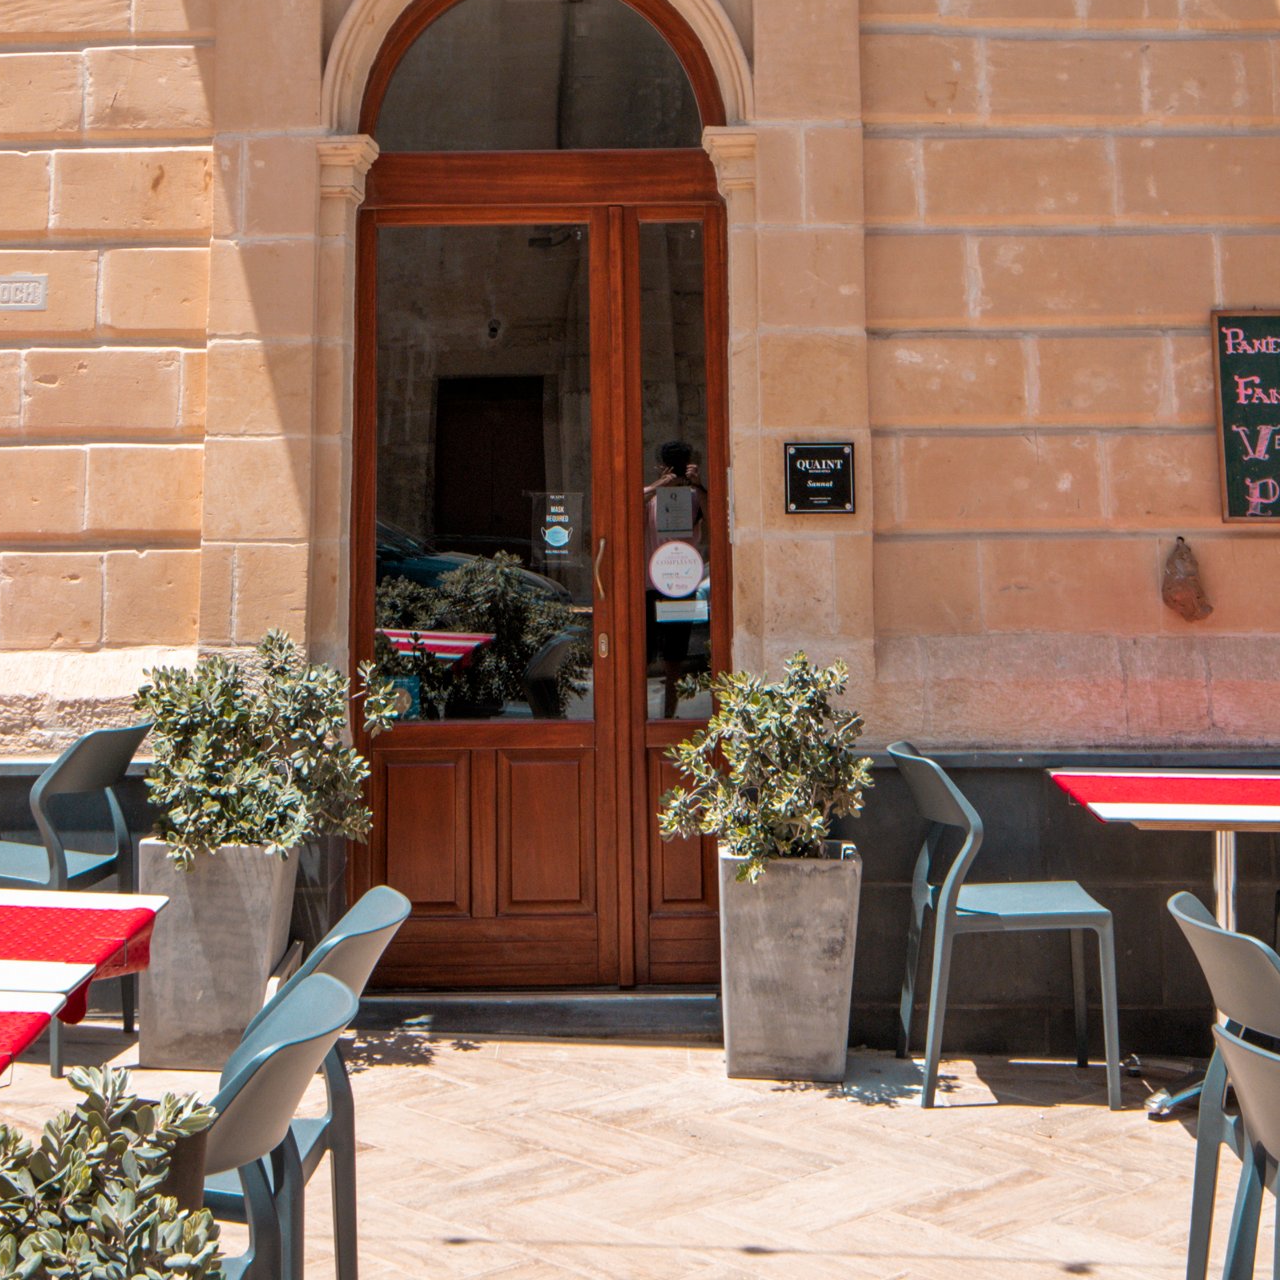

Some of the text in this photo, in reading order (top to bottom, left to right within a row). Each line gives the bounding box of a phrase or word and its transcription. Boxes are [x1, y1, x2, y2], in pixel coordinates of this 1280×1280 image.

[1221, 326, 1280, 356] PANE
[796, 459, 843, 471] QUAINT
[550, 505, 565, 513] MASK
